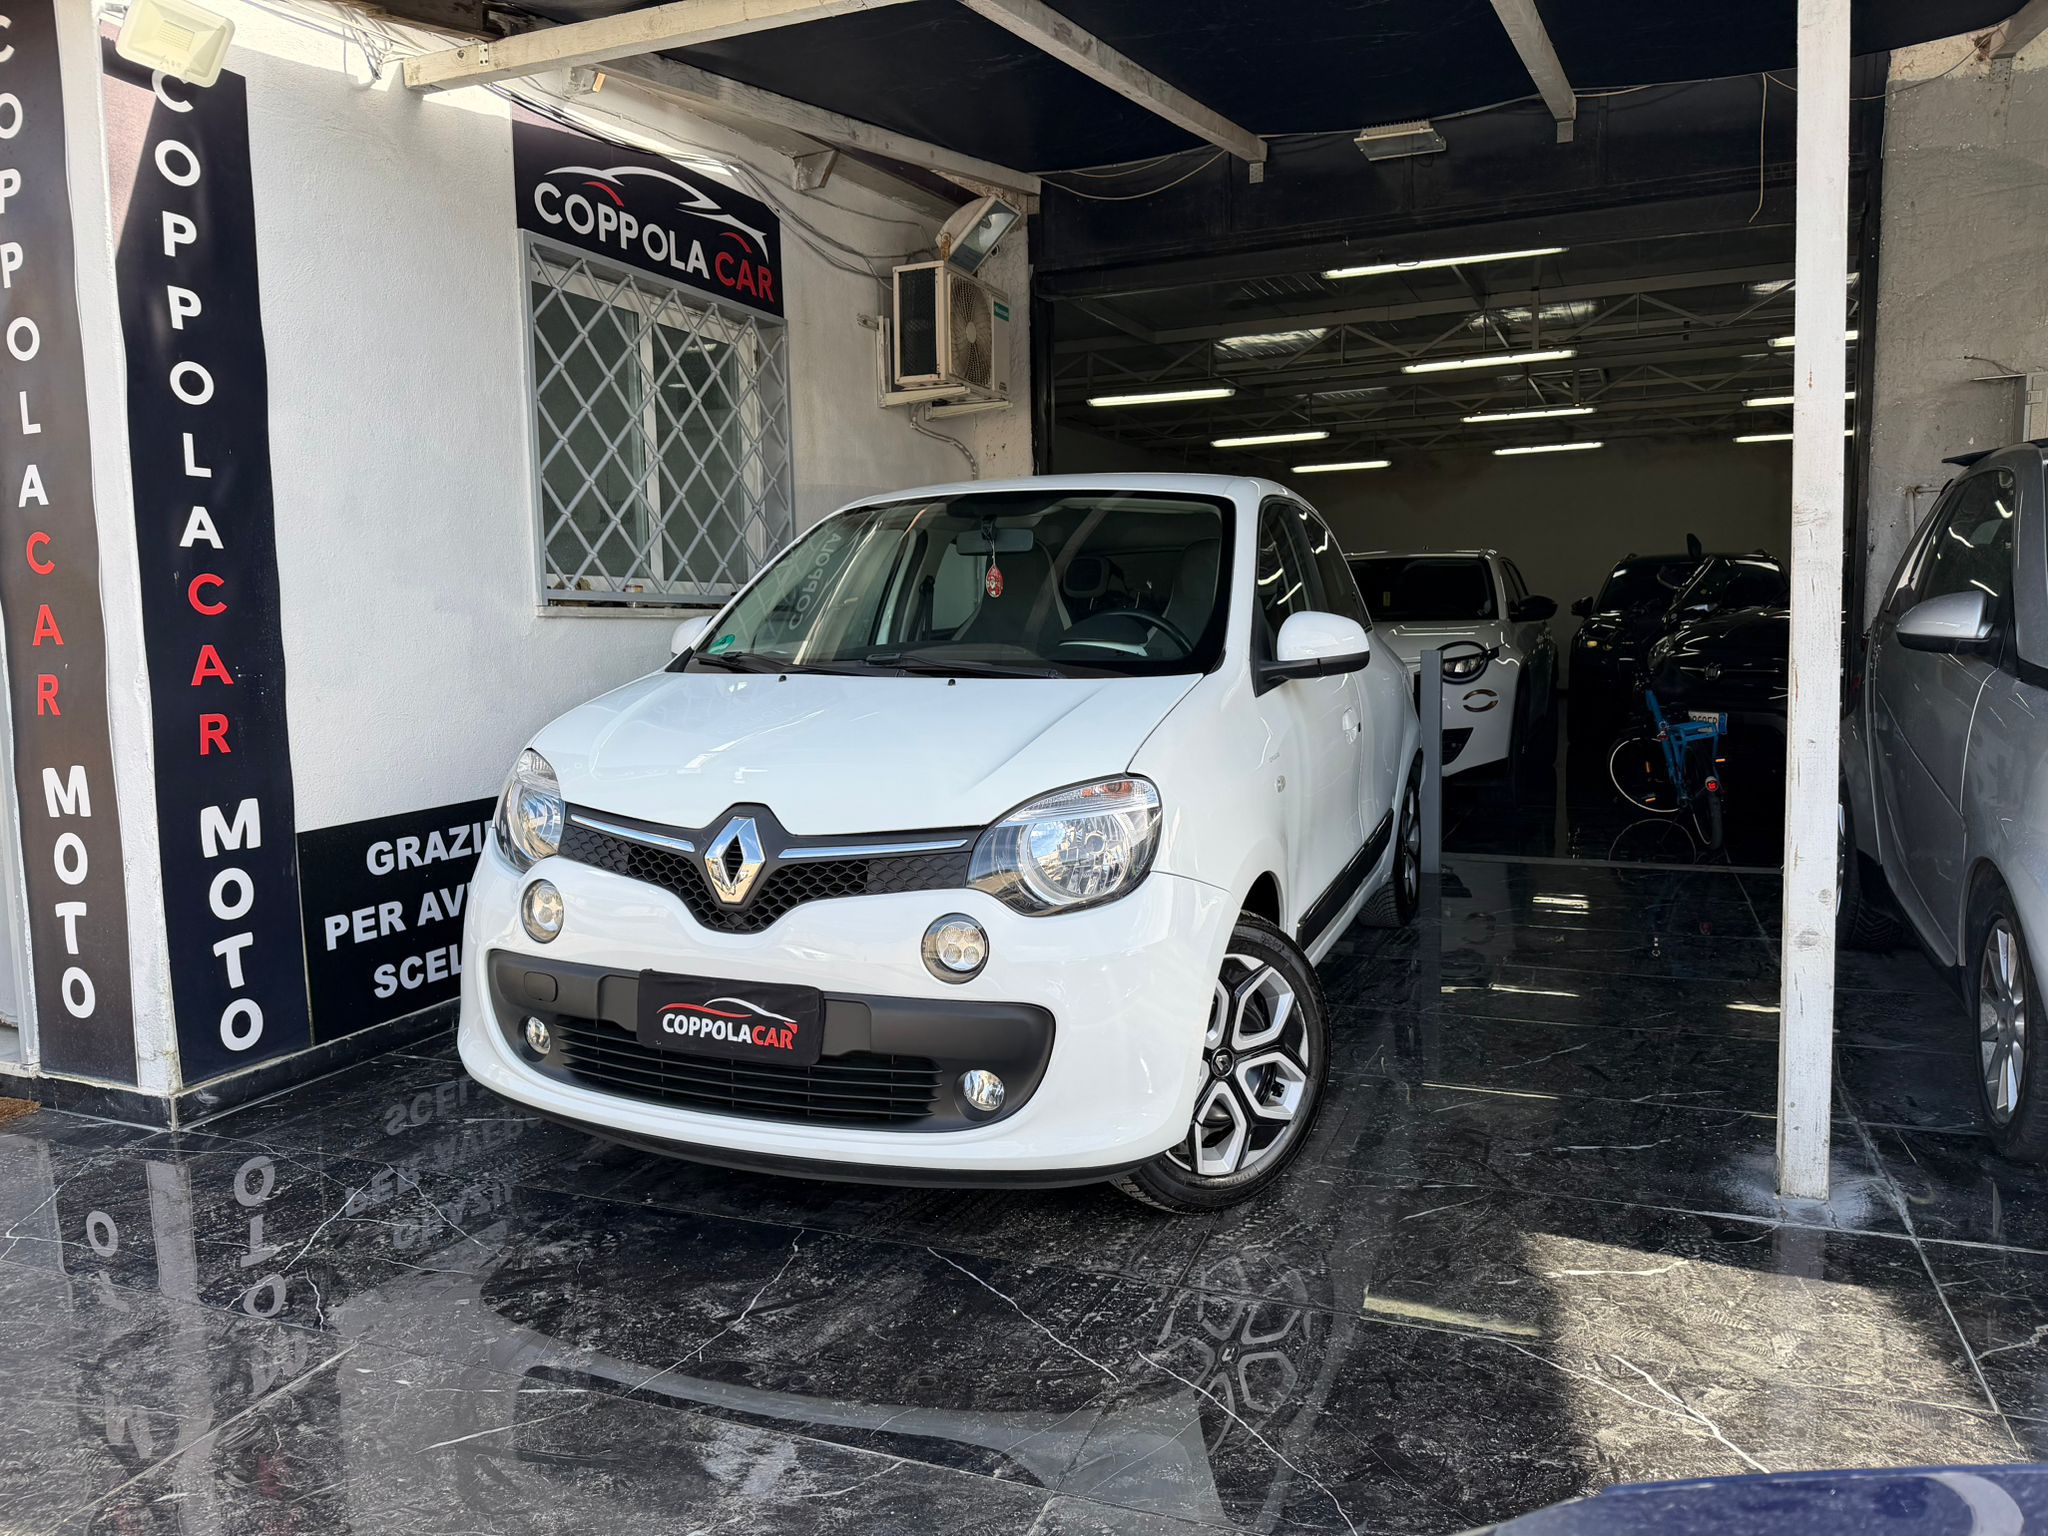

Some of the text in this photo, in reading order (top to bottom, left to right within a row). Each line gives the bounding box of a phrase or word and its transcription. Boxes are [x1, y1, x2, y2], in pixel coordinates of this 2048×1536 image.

[42, 764, 97, 1019] MOTO
[200, 797, 264, 1052] MOTO
[324, 882, 471, 951] PER AV
